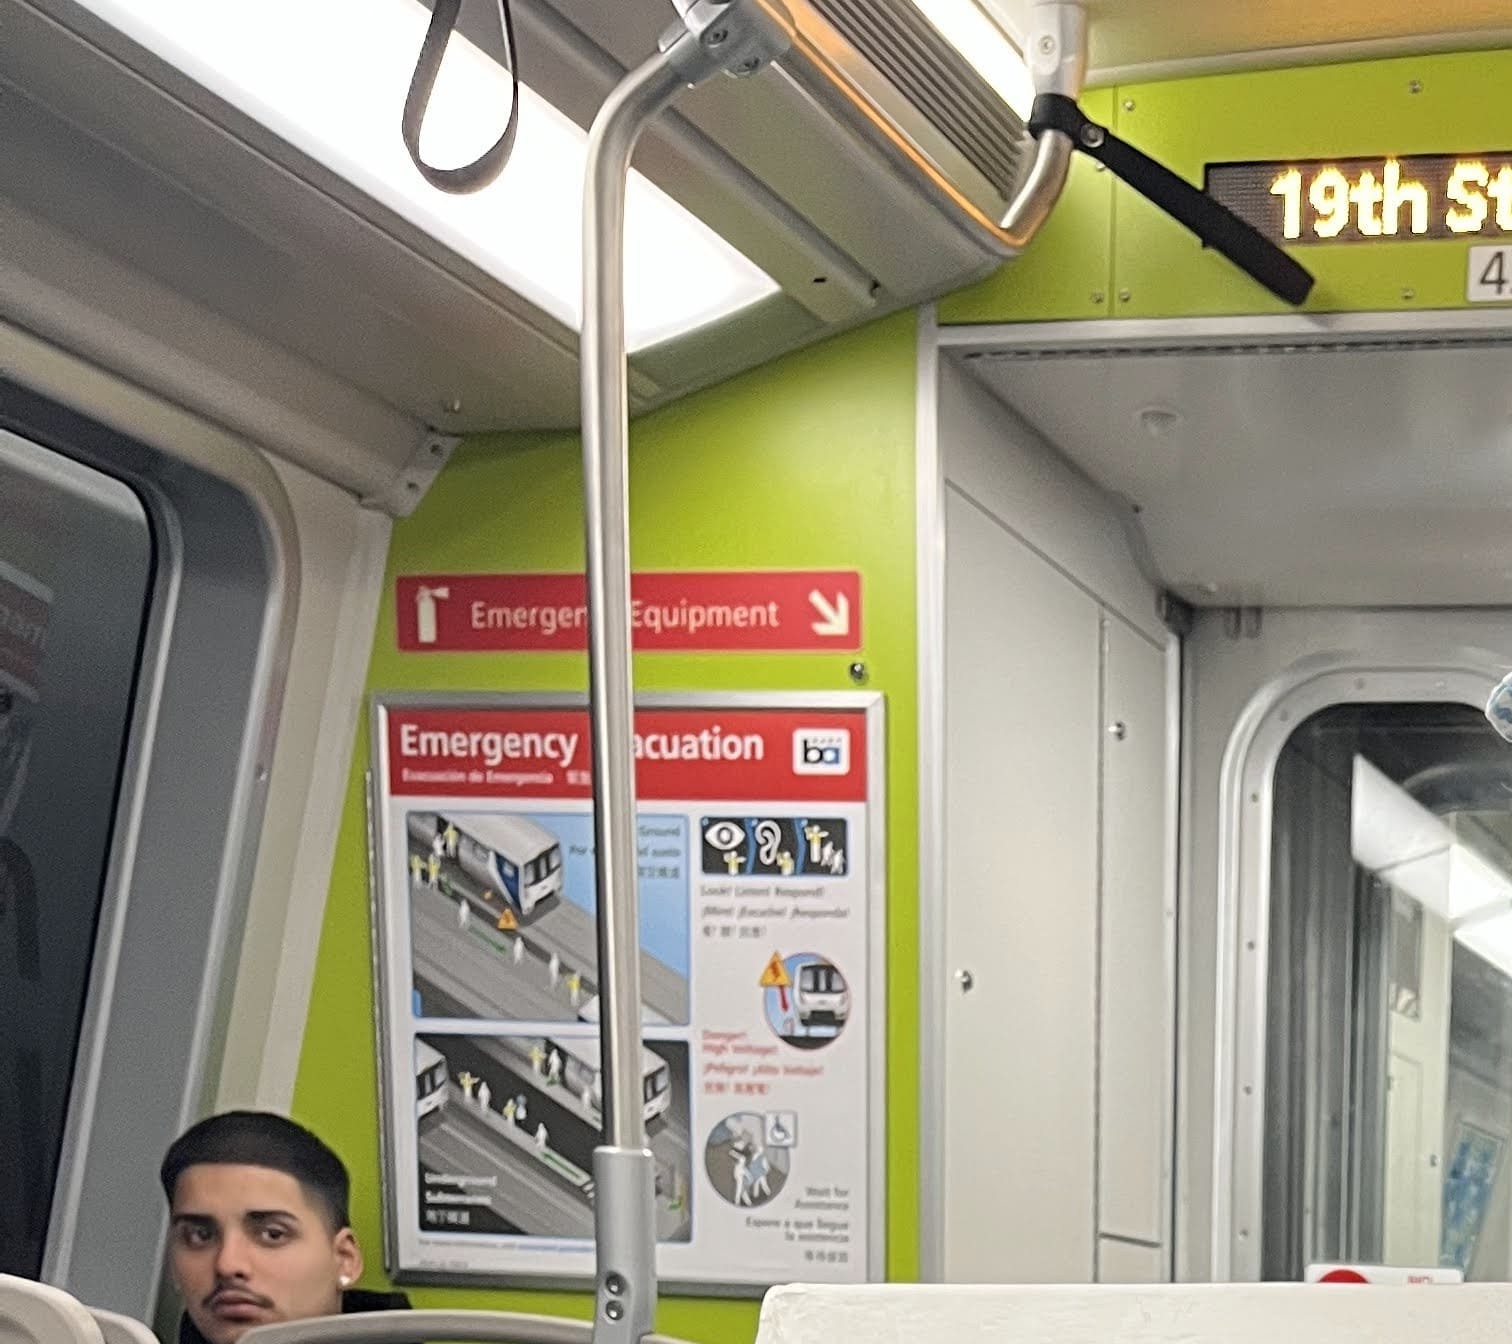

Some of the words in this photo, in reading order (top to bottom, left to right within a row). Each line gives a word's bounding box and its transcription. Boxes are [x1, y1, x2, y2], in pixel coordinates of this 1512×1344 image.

[1270, 156, 1428, 240] 19th
[471, 601, 588, 635] Emergen
[631, 598, 780, 635] Equipment
[400, 723, 579, 767] Emergency
[630, 725, 765, 761] acuation
